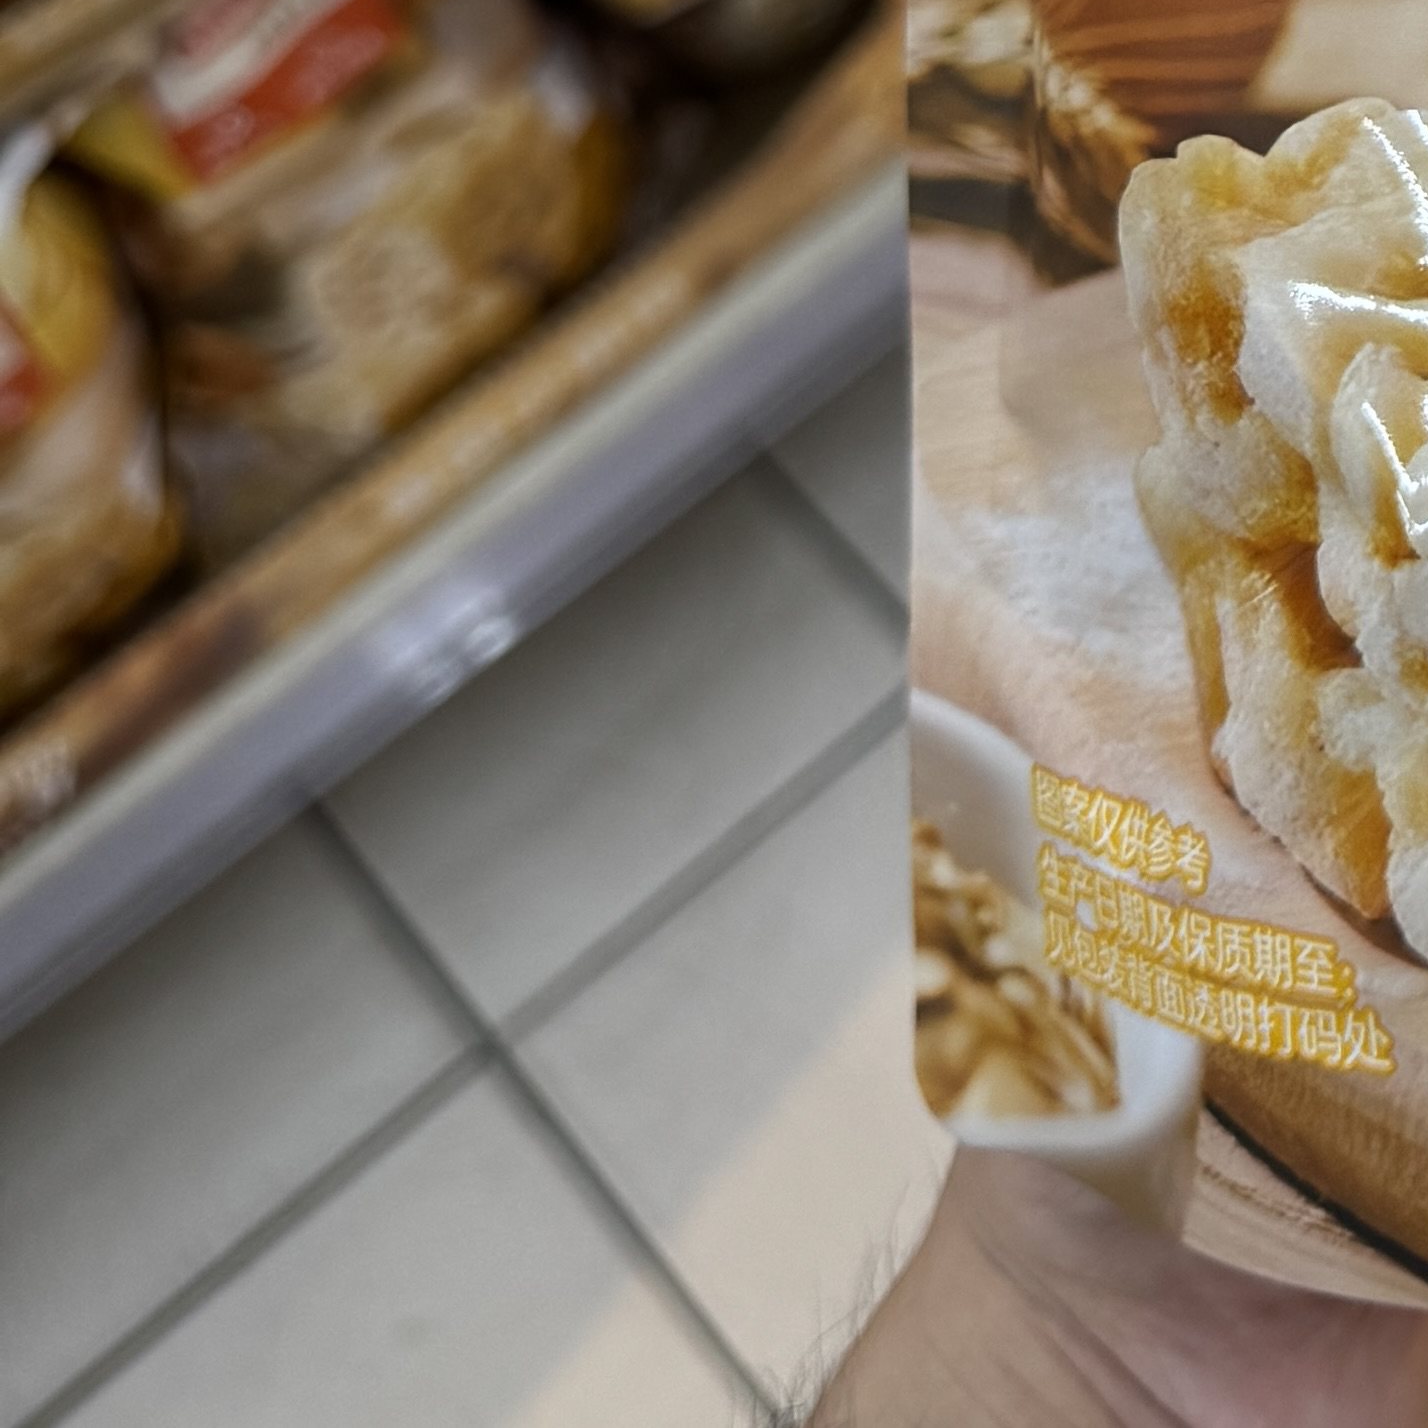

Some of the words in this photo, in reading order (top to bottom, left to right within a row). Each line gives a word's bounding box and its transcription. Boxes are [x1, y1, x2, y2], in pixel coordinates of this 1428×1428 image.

[1035, 767, 1210, 892] 图案仅供参考
